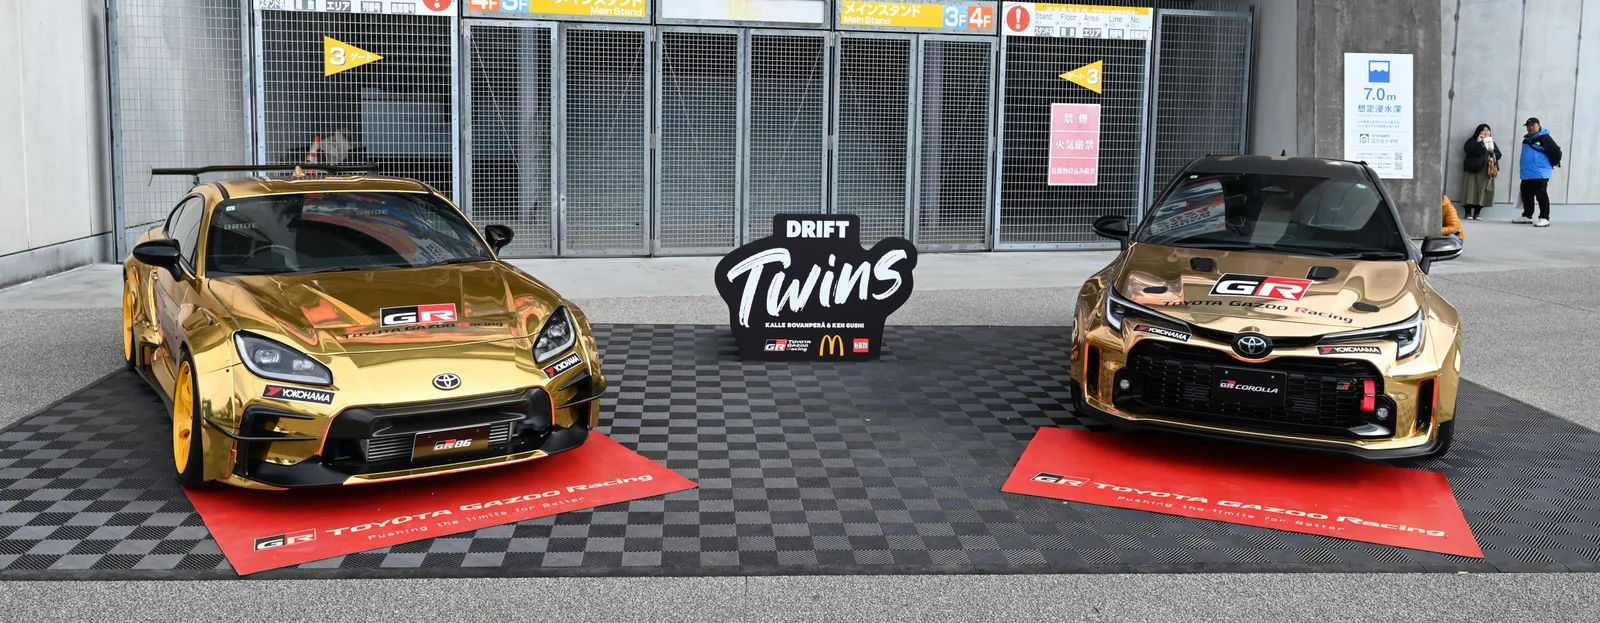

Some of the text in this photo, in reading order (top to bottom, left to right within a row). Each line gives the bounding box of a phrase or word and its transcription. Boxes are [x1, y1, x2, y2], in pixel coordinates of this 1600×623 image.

[327, 1, 350, 11] エリア
[590, 6, 643, 17] Main Stand
[844, 4, 921, 17] メインスタンド
[866, 17, 891, 25] Stand
[944, 6, 967, 27] 3F
[969, 7, 992, 28] 4F
[1084, 29, 1101, 37] エリア
[330, 47, 373, 66] 3 ゲート
[1067, 69, 1099, 85] ゲート 3
[1056, 139, 1095, 151] 火気厳禁
[223, 222, 259, 230] BRIDE
[786, 220, 849, 239] DRIFT
[727, 247, 907, 328] Twins
[1214, 278, 1307, 299] GR
[382, 309, 455, 325] GR
[1228, 300, 1288, 311] GAZOO
[1294, 307, 1354, 323] Racing
[343, 327, 402, 339] TOYOTA
[405, 323, 456, 331] GAZOO
[1148, 327, 1187, 340] YOKOHAMA
[553, 354, 580, 373] YOKOHAMA
[282, 388, 330, 402] YOKOHAMA
[1235, 384, 1279, 394] COROLLA
[256, 473, 654, 550] GR TOYOTA GAZOO Racing
[1034, 475, 1446, 537] GR TOYOTA GAZOO Racing
[1116, 495, 1173, 508] Pushing
[1182, 504, 1205, 512] the
[1212, 508, 1255, 519] limits
[1294, 520, 1346, 531] Better
[367, 496, 585, 541] Pushing the limits for Better
